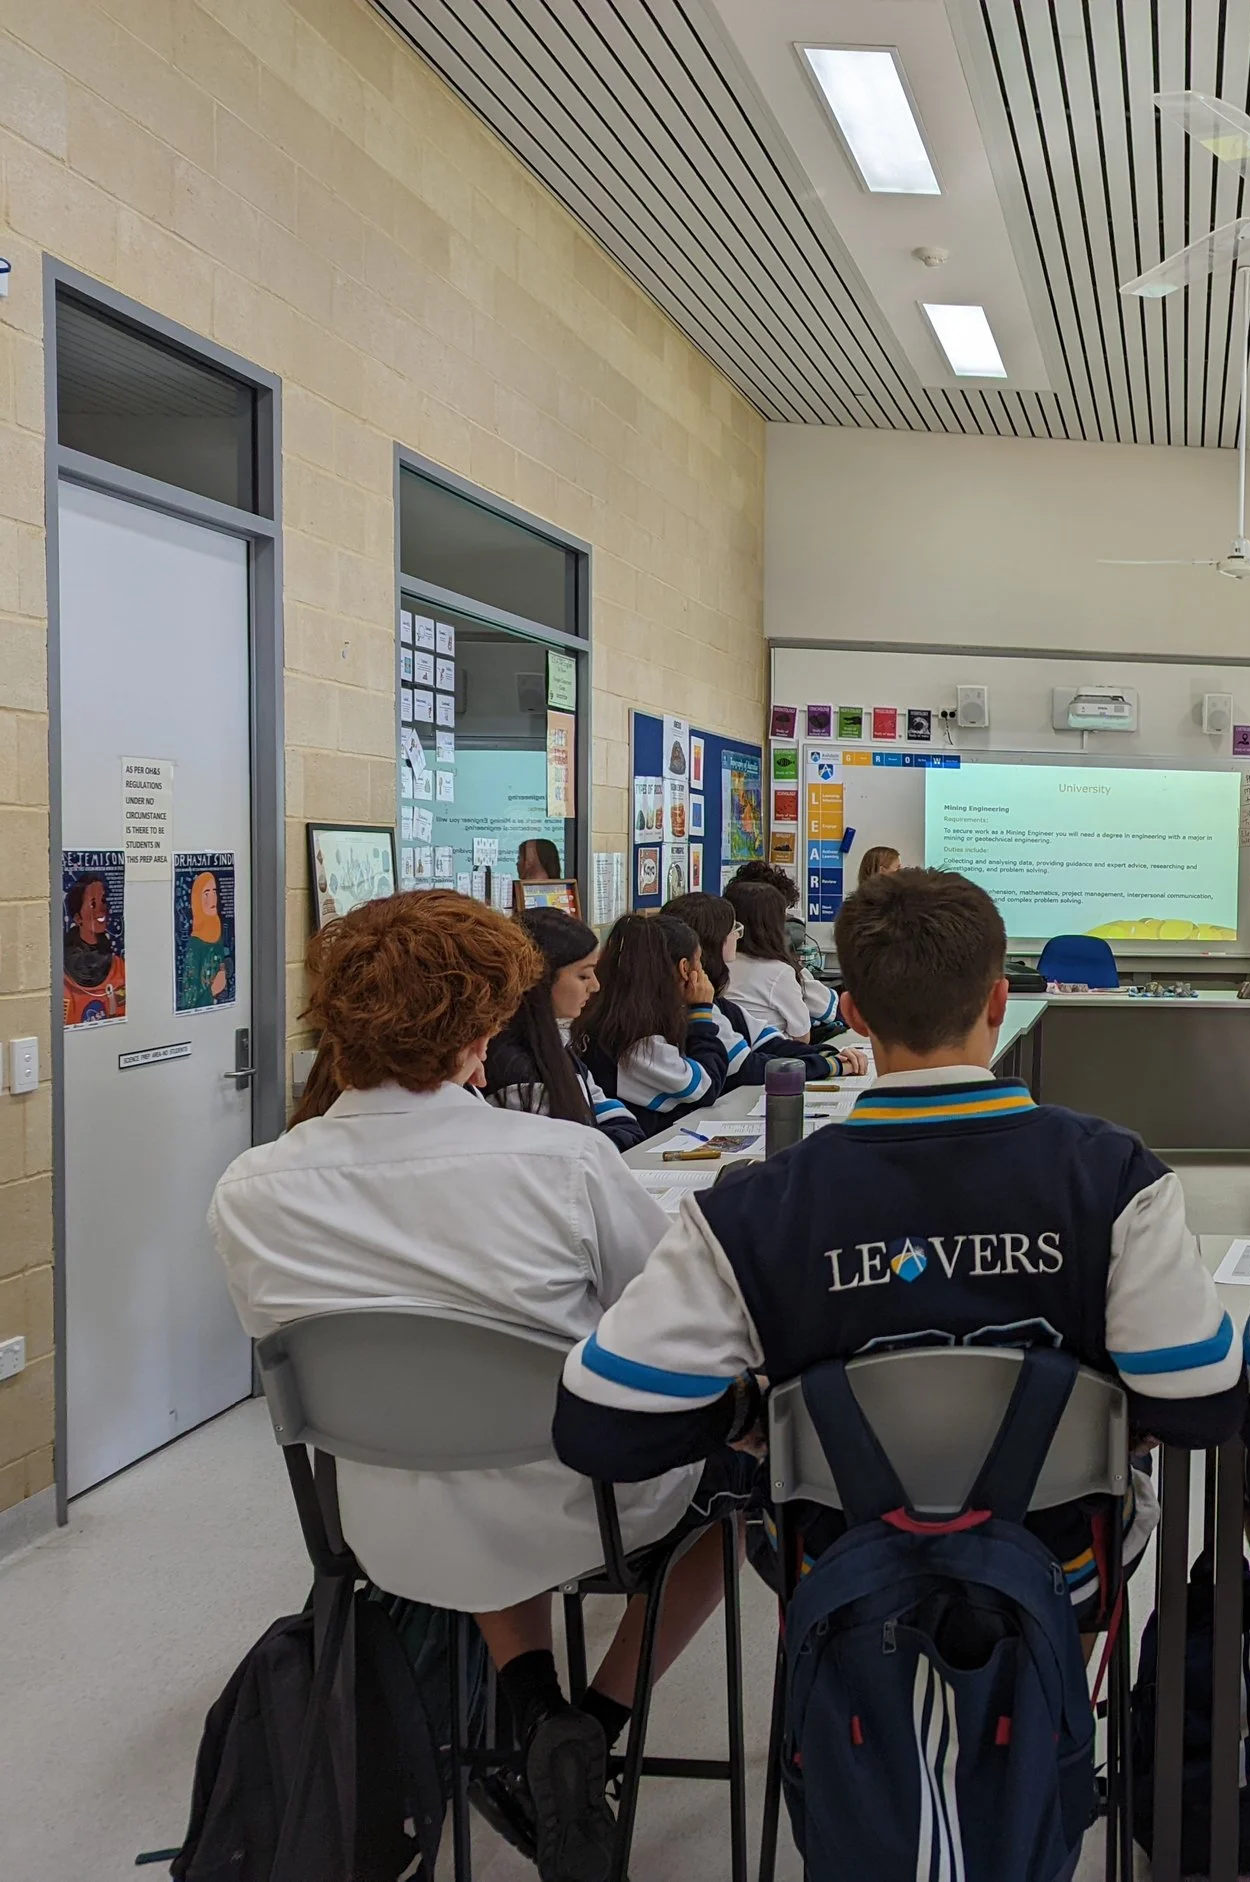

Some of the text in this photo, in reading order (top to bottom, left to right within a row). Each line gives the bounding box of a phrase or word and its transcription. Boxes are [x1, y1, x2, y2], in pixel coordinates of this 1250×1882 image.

[134, 766, 144, 774] PER
[126, 781, 162, 789] REGULATIONS
[1058, 783, 1111, 795] University
[126, 797, 145, 805] UNDER
[812, 793, 819, 804] L
[969, 805, 1009, 813] Engineering
[126, 812, 167, 820] CIRCUMSTANCE
[811, 821, 819, 832] E
[77, 852, 124, 866] JEMISON
[810, 848, 820, 860] A
[811, 876, 819, 888] R
[810, 903, 819, 915] N
[124, 1055, 139, 1064] SCIENCE
[169, 1046, 188, 1055] STUDENTS
[824, 1232, 1064, 1291] LEAVERS
